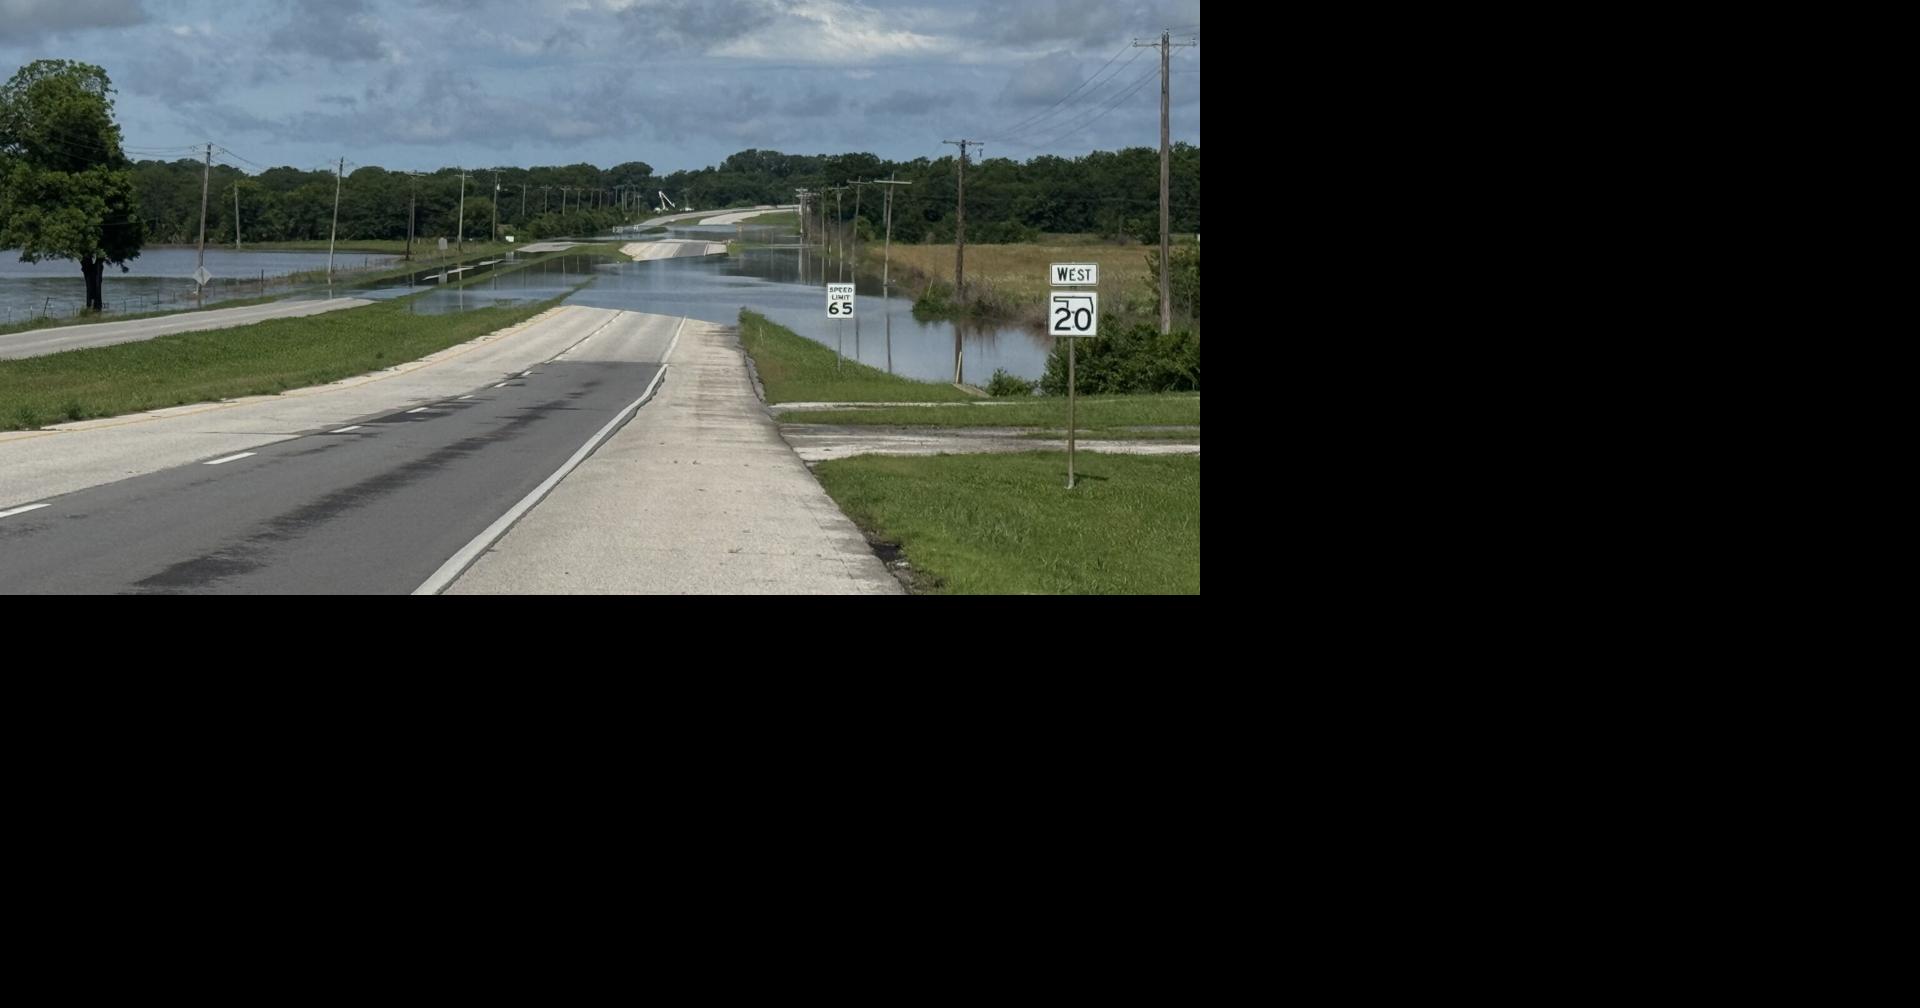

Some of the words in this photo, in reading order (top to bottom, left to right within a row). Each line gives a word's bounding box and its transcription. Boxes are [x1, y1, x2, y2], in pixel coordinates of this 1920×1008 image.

[1057, 267, 1092, 282] WEST
[828, 302, 853, 315] 65
[1054, 307, 1092, 331] 20
